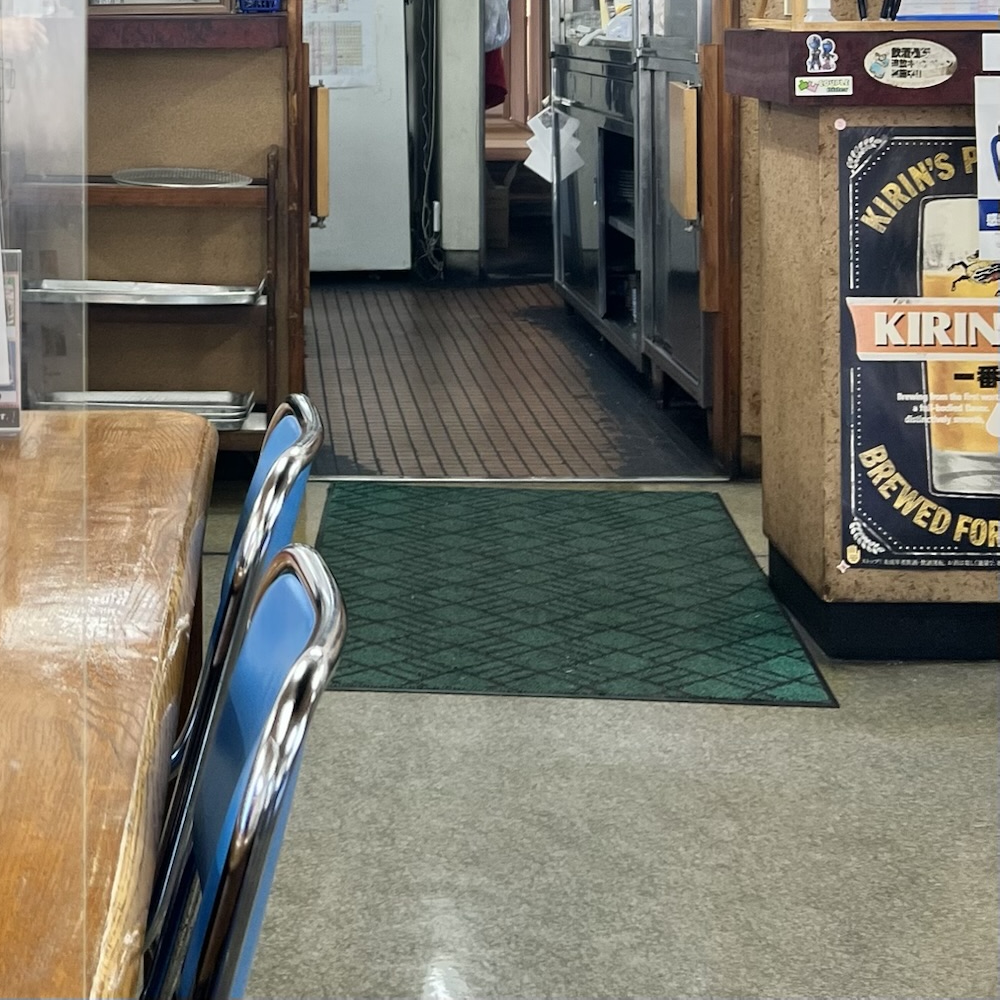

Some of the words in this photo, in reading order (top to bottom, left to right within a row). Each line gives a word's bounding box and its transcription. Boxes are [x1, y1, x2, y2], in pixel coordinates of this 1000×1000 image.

[860, 152, 956, 234] KIRIN'S
[874, 311, 1000, 347] KIRIN
[858, 444, 952, 535] BREWED
[953, 514, 1000, 548] FOR
